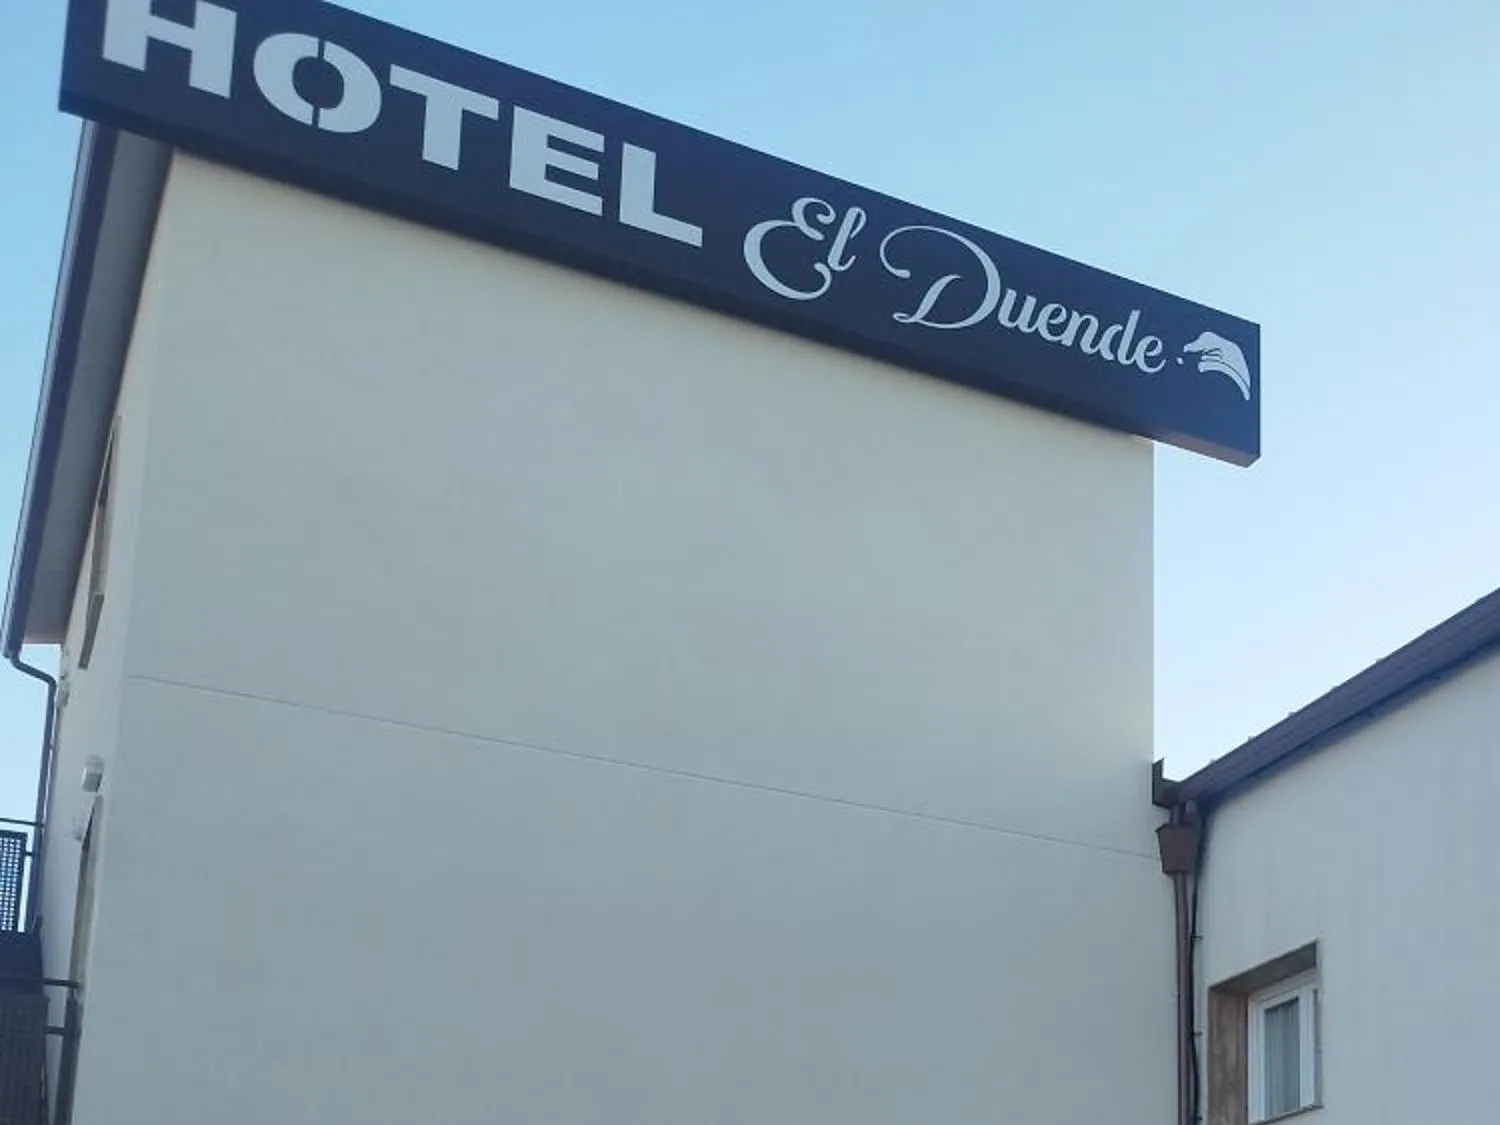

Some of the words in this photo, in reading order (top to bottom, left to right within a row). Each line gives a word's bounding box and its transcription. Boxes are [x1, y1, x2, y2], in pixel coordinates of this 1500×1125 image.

[101, 0, 703, 248] HOTEL
[743, 197, 867, 300] El
[880, 225, 1166, 374] Duende
